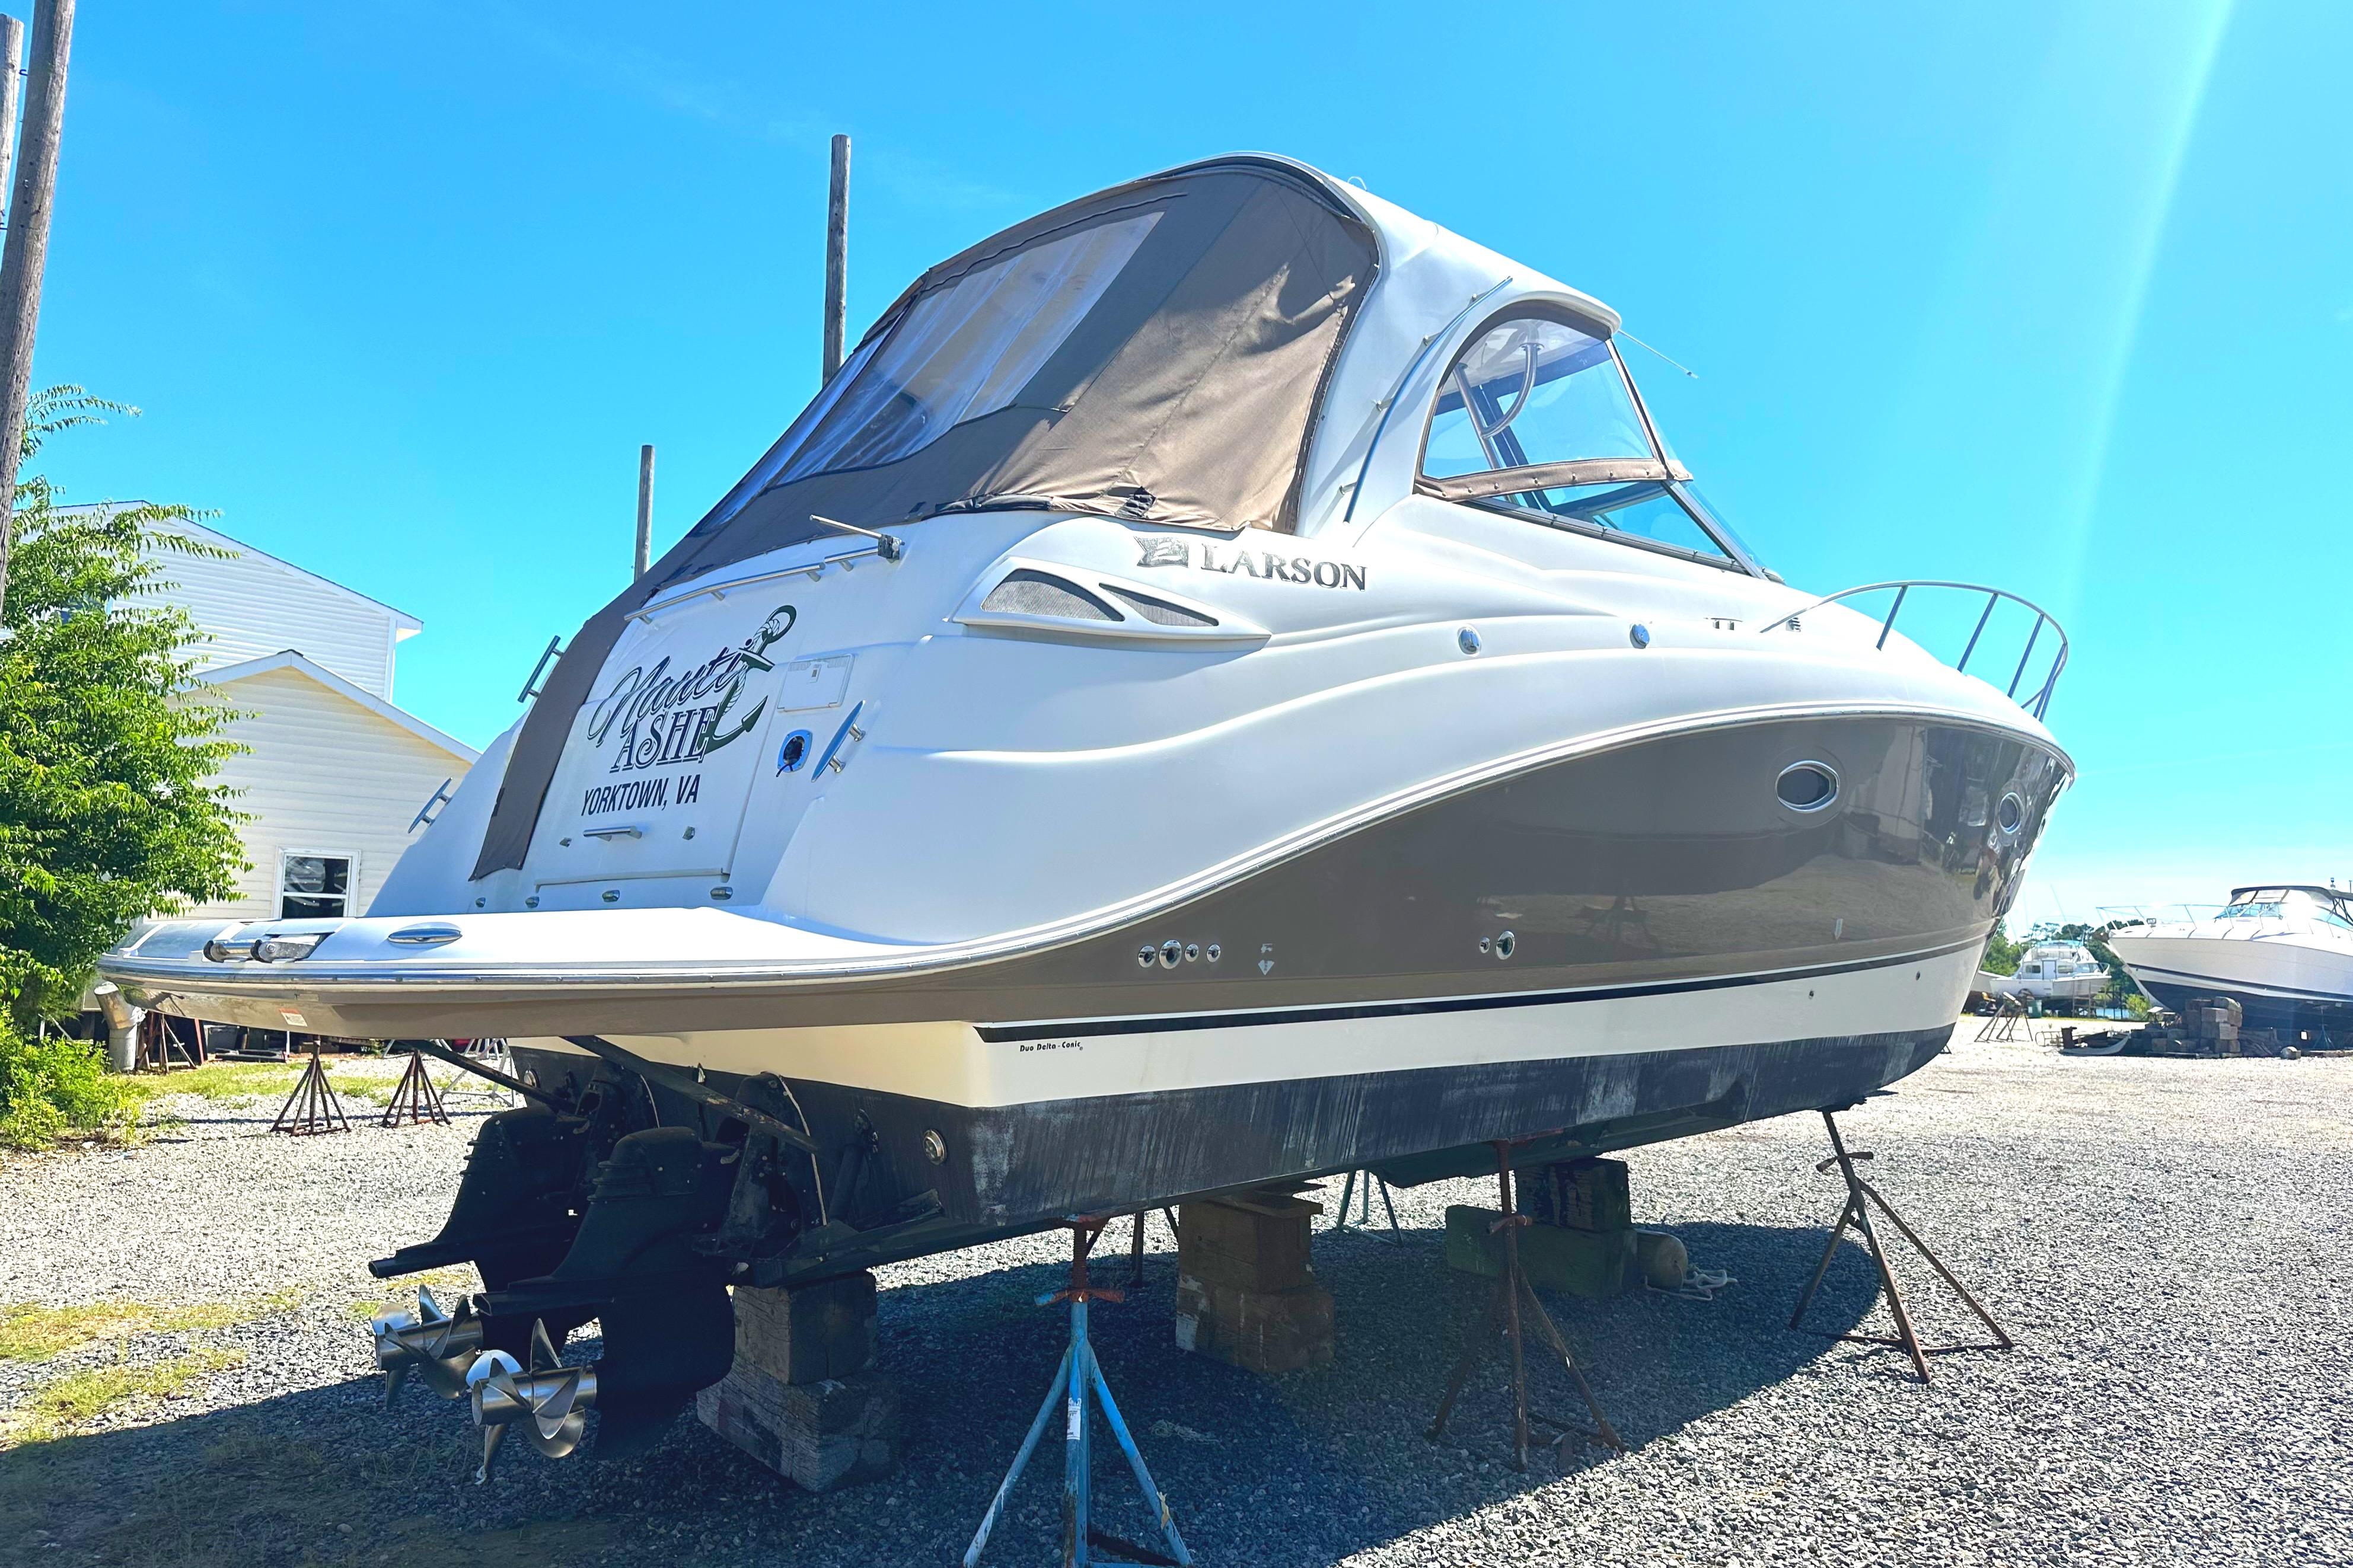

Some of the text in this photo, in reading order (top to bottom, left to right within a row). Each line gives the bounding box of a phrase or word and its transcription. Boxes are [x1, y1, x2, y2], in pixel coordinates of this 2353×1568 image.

[1201, 543, 1367, 592] LARSON
[587, 638, 754, 748] Nauti
[609, 702, 719, 773] ASHE
[581, 774, 701, 816] YORKTOWN, VA
